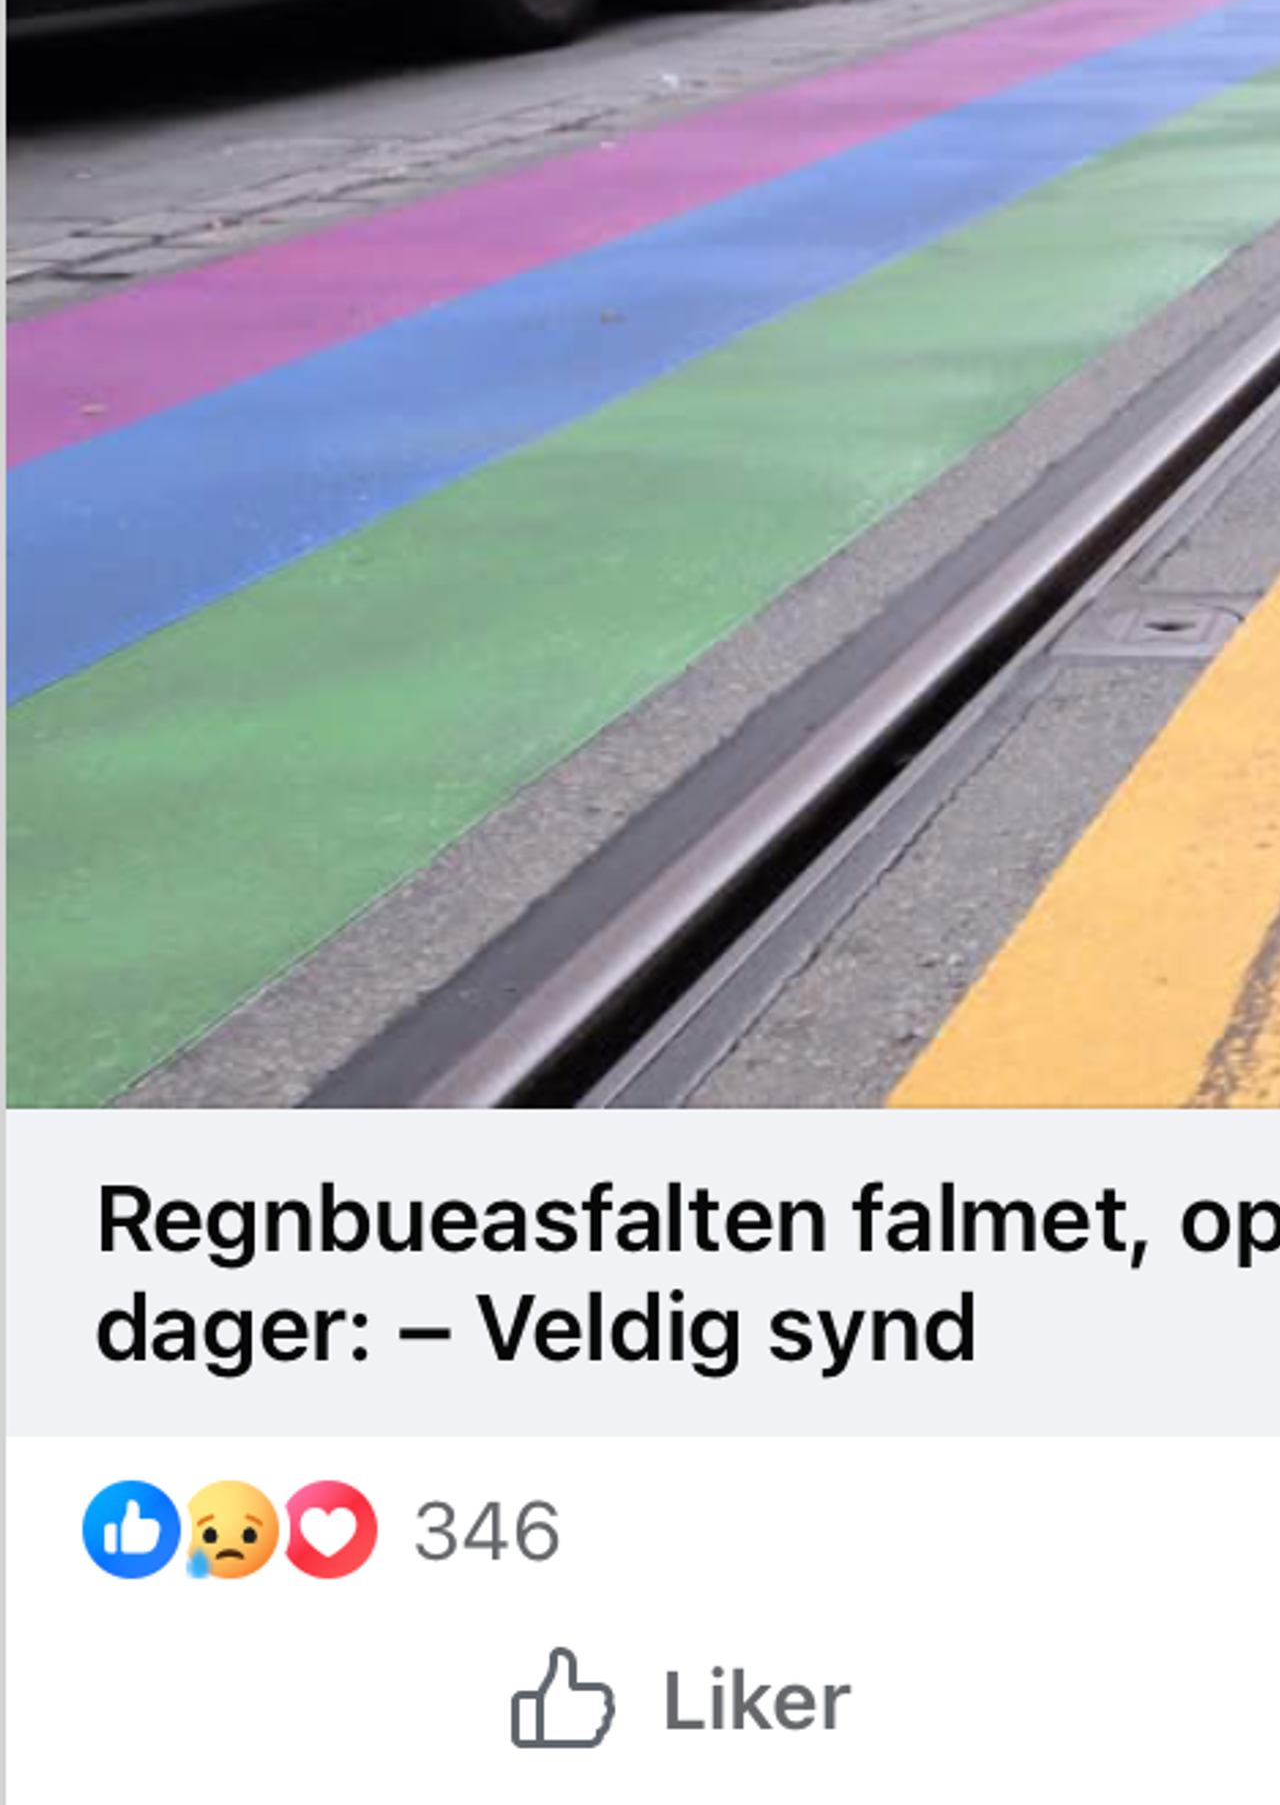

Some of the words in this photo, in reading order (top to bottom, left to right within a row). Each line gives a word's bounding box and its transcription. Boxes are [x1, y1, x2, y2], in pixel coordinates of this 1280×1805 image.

[100, 1180, 826, 1270] Regnbueasfalten
[851, 1180, 1148, 1270] falmet,
[96, 1290, 369, 1380] dager:
[475, 1288, 740, 1380] Veldig
[769, 1290, 975, 1380] synd
[415, 1499, 559, 1562] 346
[666, 1665, 852, 1731] Liker
